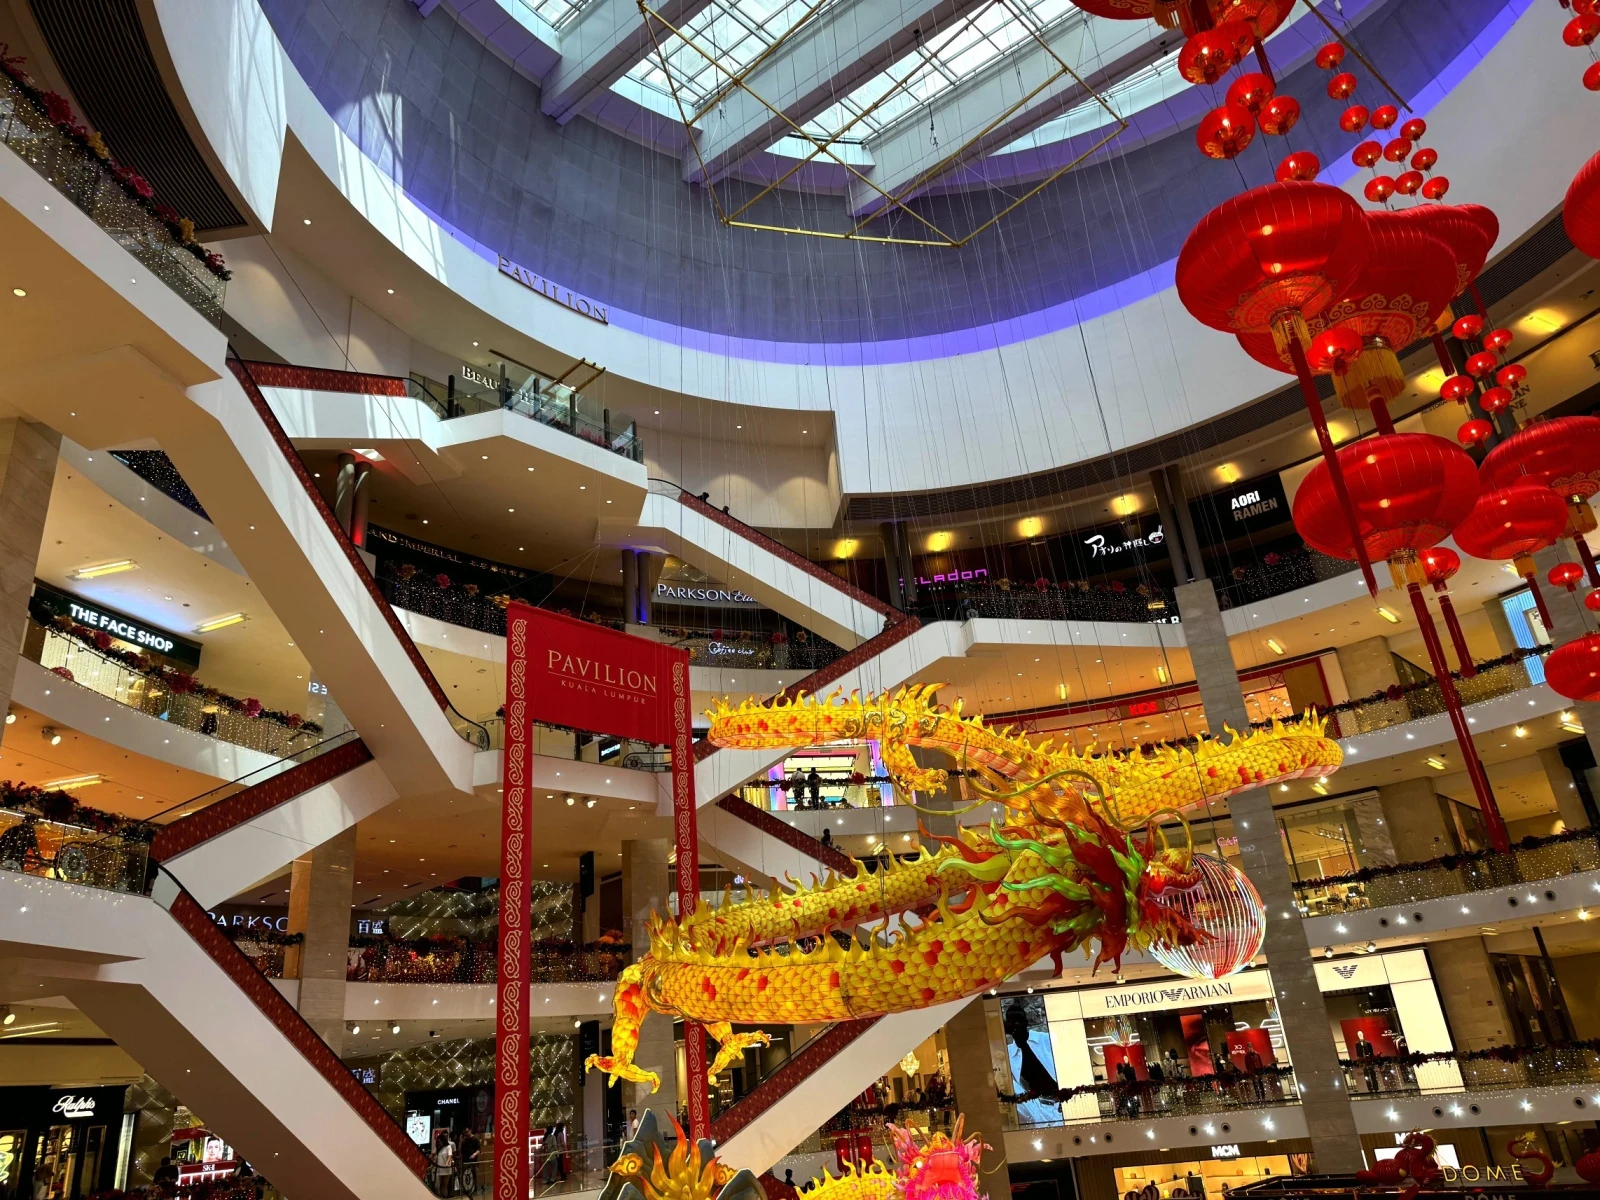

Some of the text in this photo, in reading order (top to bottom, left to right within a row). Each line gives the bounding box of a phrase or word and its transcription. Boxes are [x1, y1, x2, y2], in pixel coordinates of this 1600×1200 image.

[498, 253, 609, 324] PAVILION
[1231, 490, 1261, 510] AORI
[1233, 497, 1278, 521] RAMEN
[657, 583, 731, 601] PARKSON
[70, 603, 174, 652] THE FACE SHOP
[547, 649, 657, 693] PAVILION
[561, 680, 646, 705] KUALA LUMPUR
[1128, 700, 1158, 717] KIDS
[1104, 982, 1233, 1009] EMPORIO ARMANI
[1211, 1144, 1240, 1158] MCM
